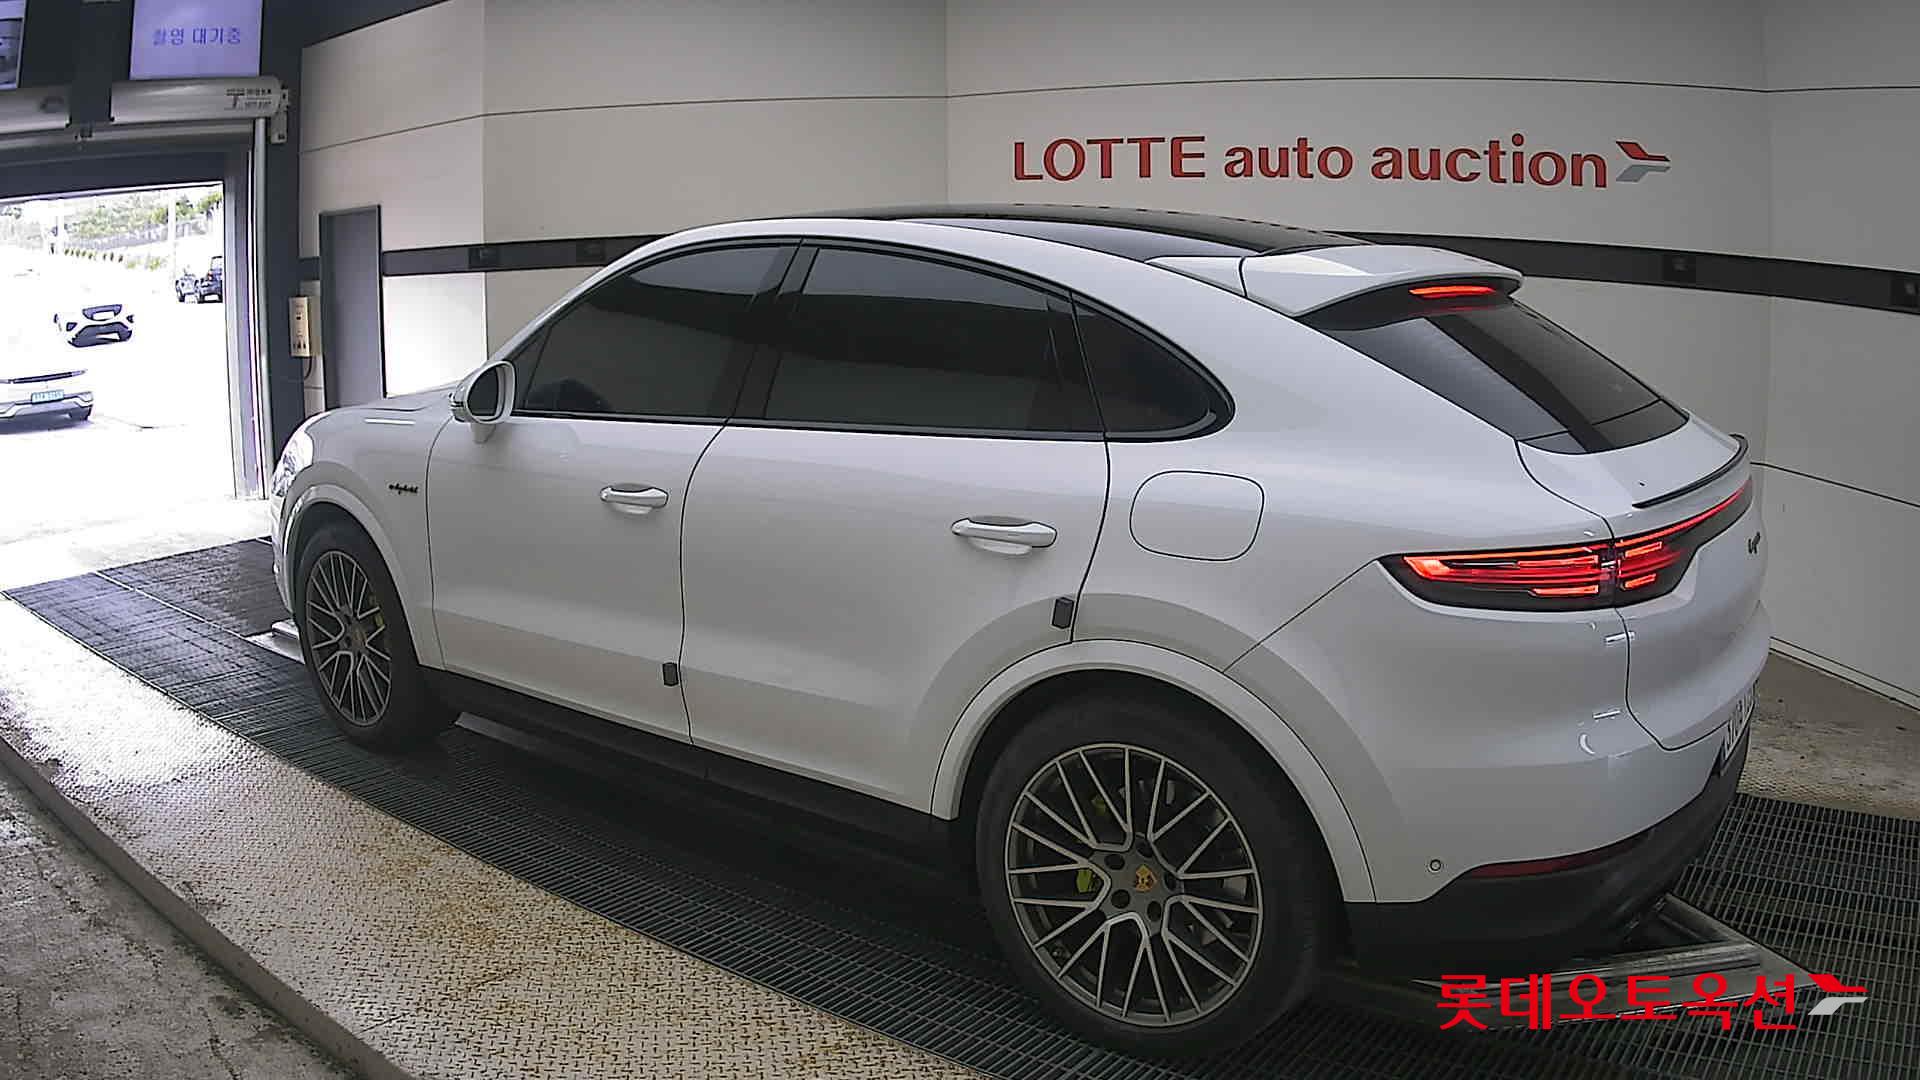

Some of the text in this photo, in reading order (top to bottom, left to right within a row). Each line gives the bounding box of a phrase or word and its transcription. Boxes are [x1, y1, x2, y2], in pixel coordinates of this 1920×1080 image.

[193, 28, 241, 45] 대기중
[1013, 133, 1608, 188] LOTTE auto auction
